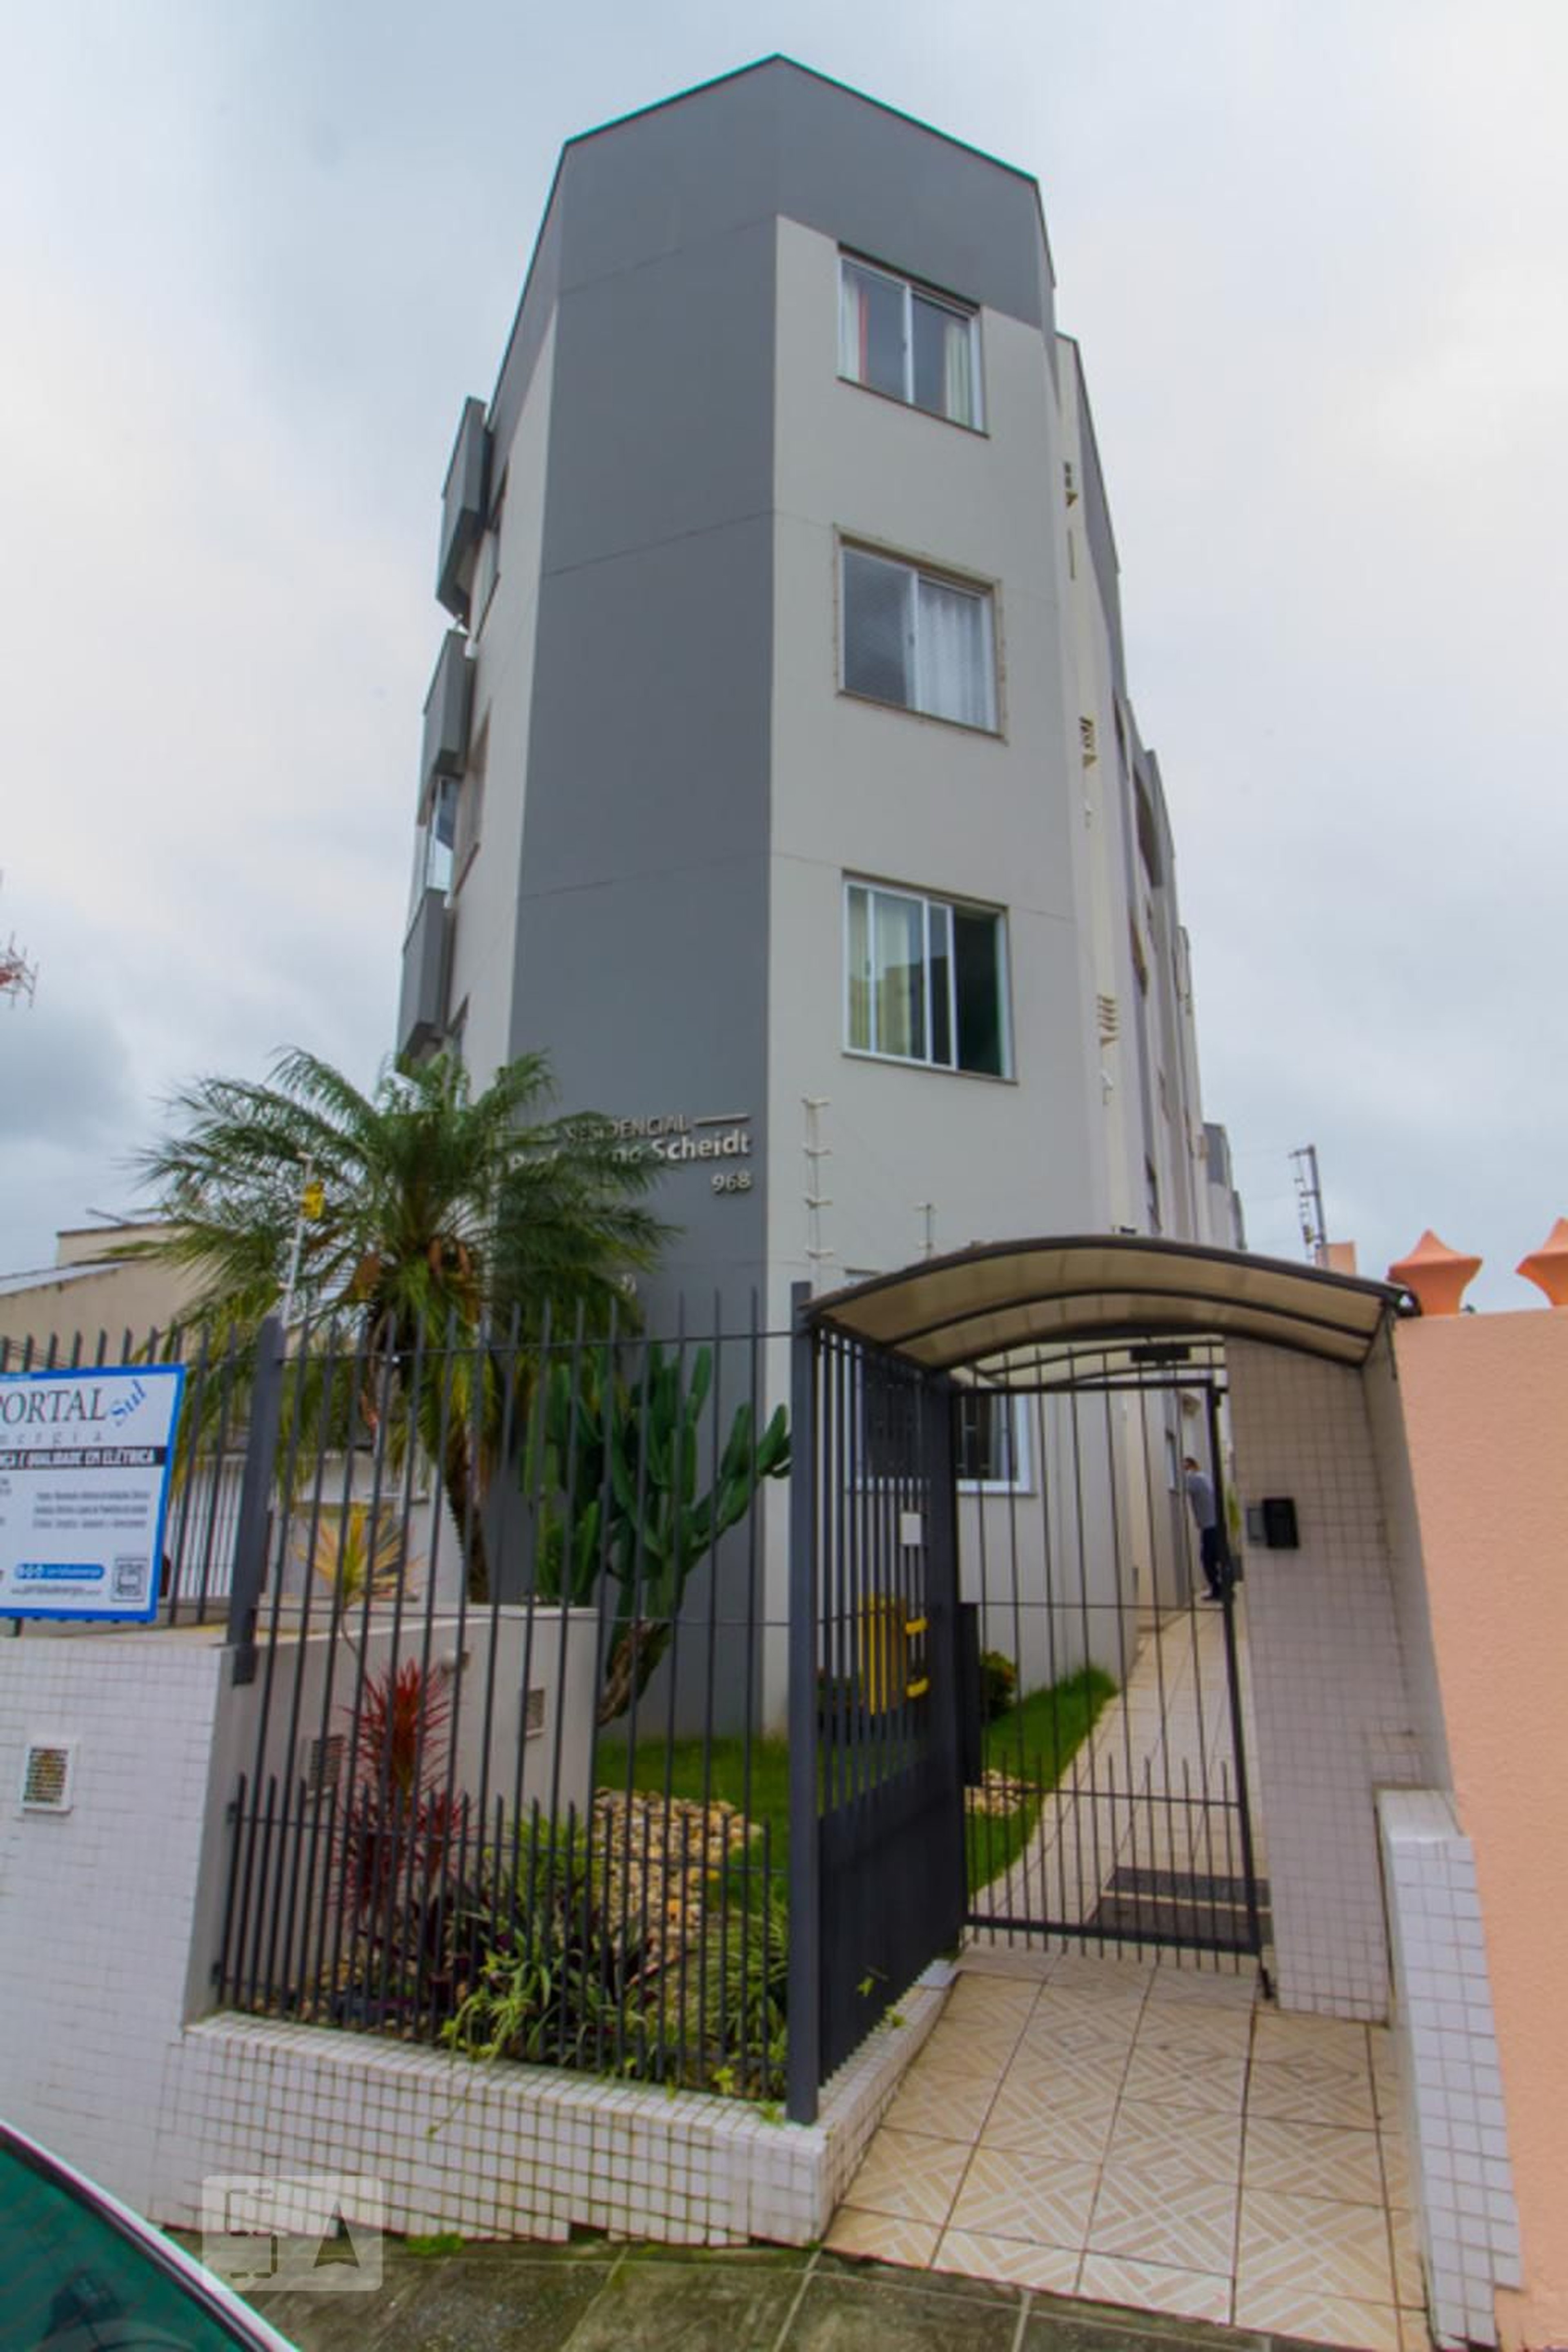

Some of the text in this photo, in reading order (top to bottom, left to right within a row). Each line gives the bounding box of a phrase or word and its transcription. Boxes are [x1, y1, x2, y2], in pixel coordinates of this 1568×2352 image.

[651, 1128, 749, 1161] Scheidt
[711, 1171, 751, 1192] 968
[0, 1388, 106, 1423] ORTAL
